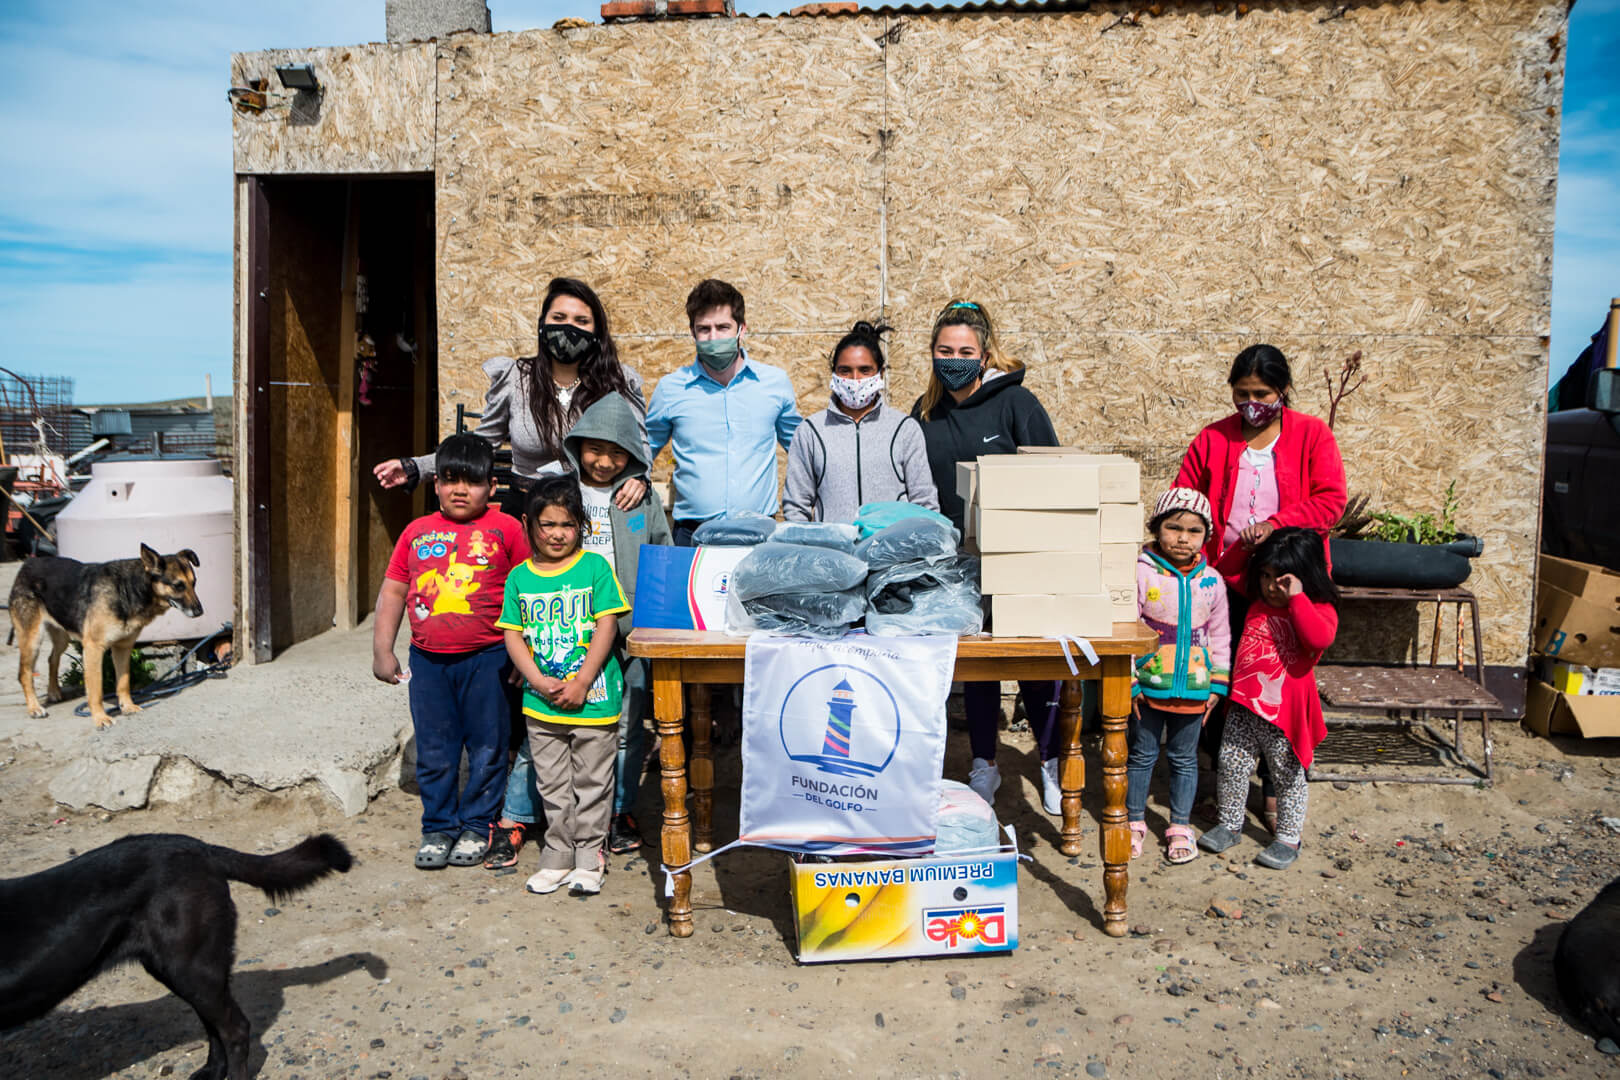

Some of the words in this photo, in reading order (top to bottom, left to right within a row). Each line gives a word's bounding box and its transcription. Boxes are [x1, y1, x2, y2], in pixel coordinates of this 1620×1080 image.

[417, 543, 447, 560] GO
[520, 591, 594, 627] BRASIL
[791, 775, 879, 801] FUNDACIÓN
[805, 792, 824, 805] DEL
[825, 798, 863, 813] GOLFO
[815, 867, 904, 887] BANANAS
[911, 863, 993, 883] PREMIUM
[926, 910, 1006, 949] Dole
